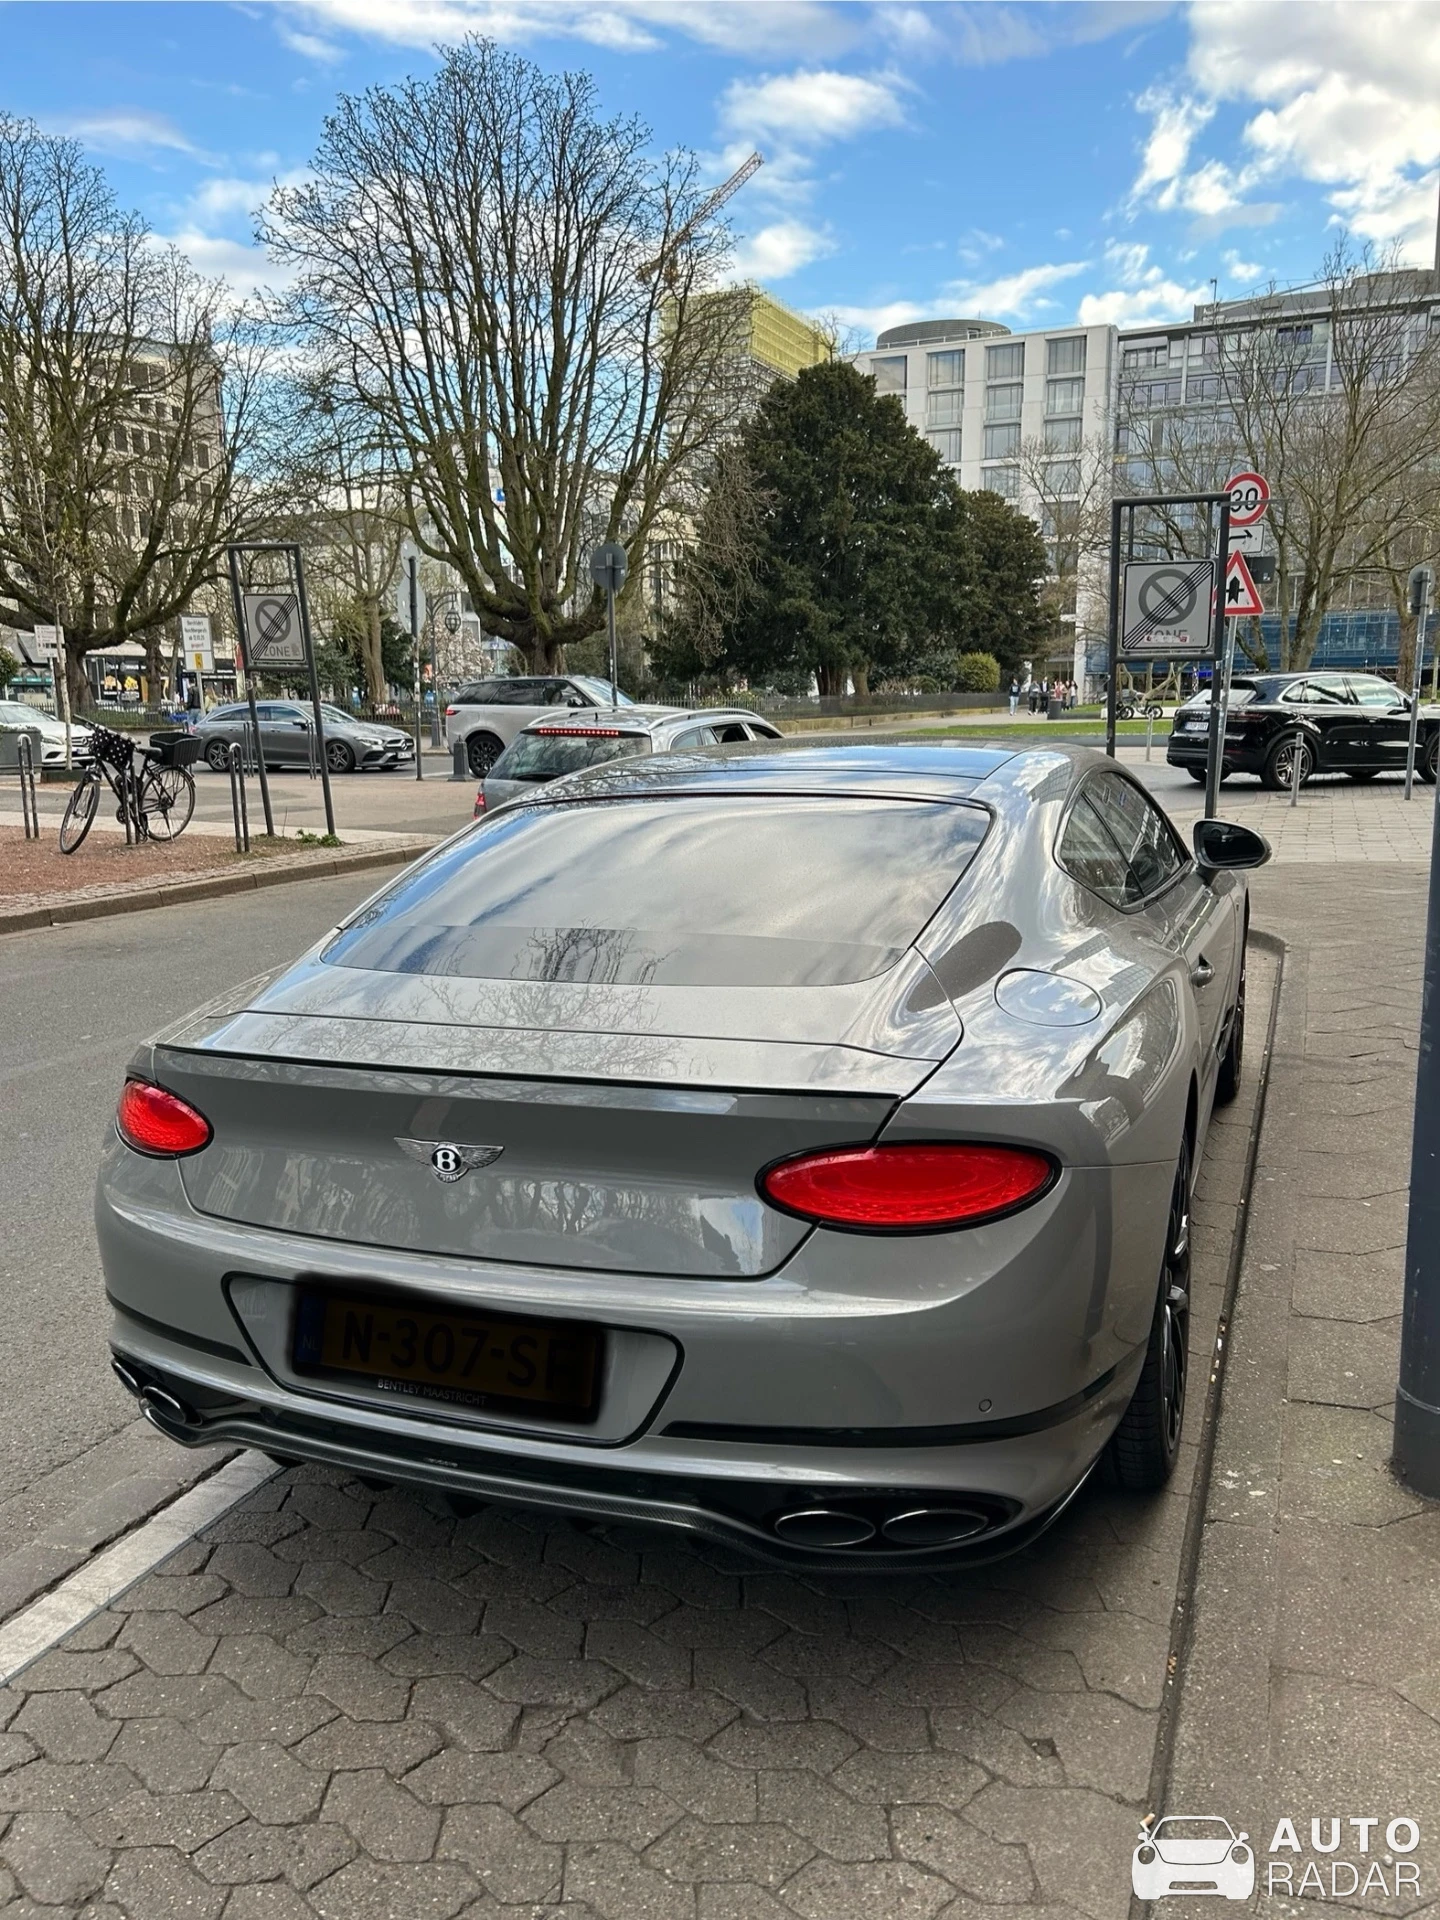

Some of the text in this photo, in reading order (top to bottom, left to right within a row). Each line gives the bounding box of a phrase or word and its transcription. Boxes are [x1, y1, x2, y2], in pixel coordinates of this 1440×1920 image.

[1231, 487, 1259, 513] 30
[263, 645, 291, 657] ZONE
[436, 1149, 456, 1172] B
[302, 1334, 320, 1351] NL
[377, 1379, 489, 1406] BENTLEY MAASTRICHT
